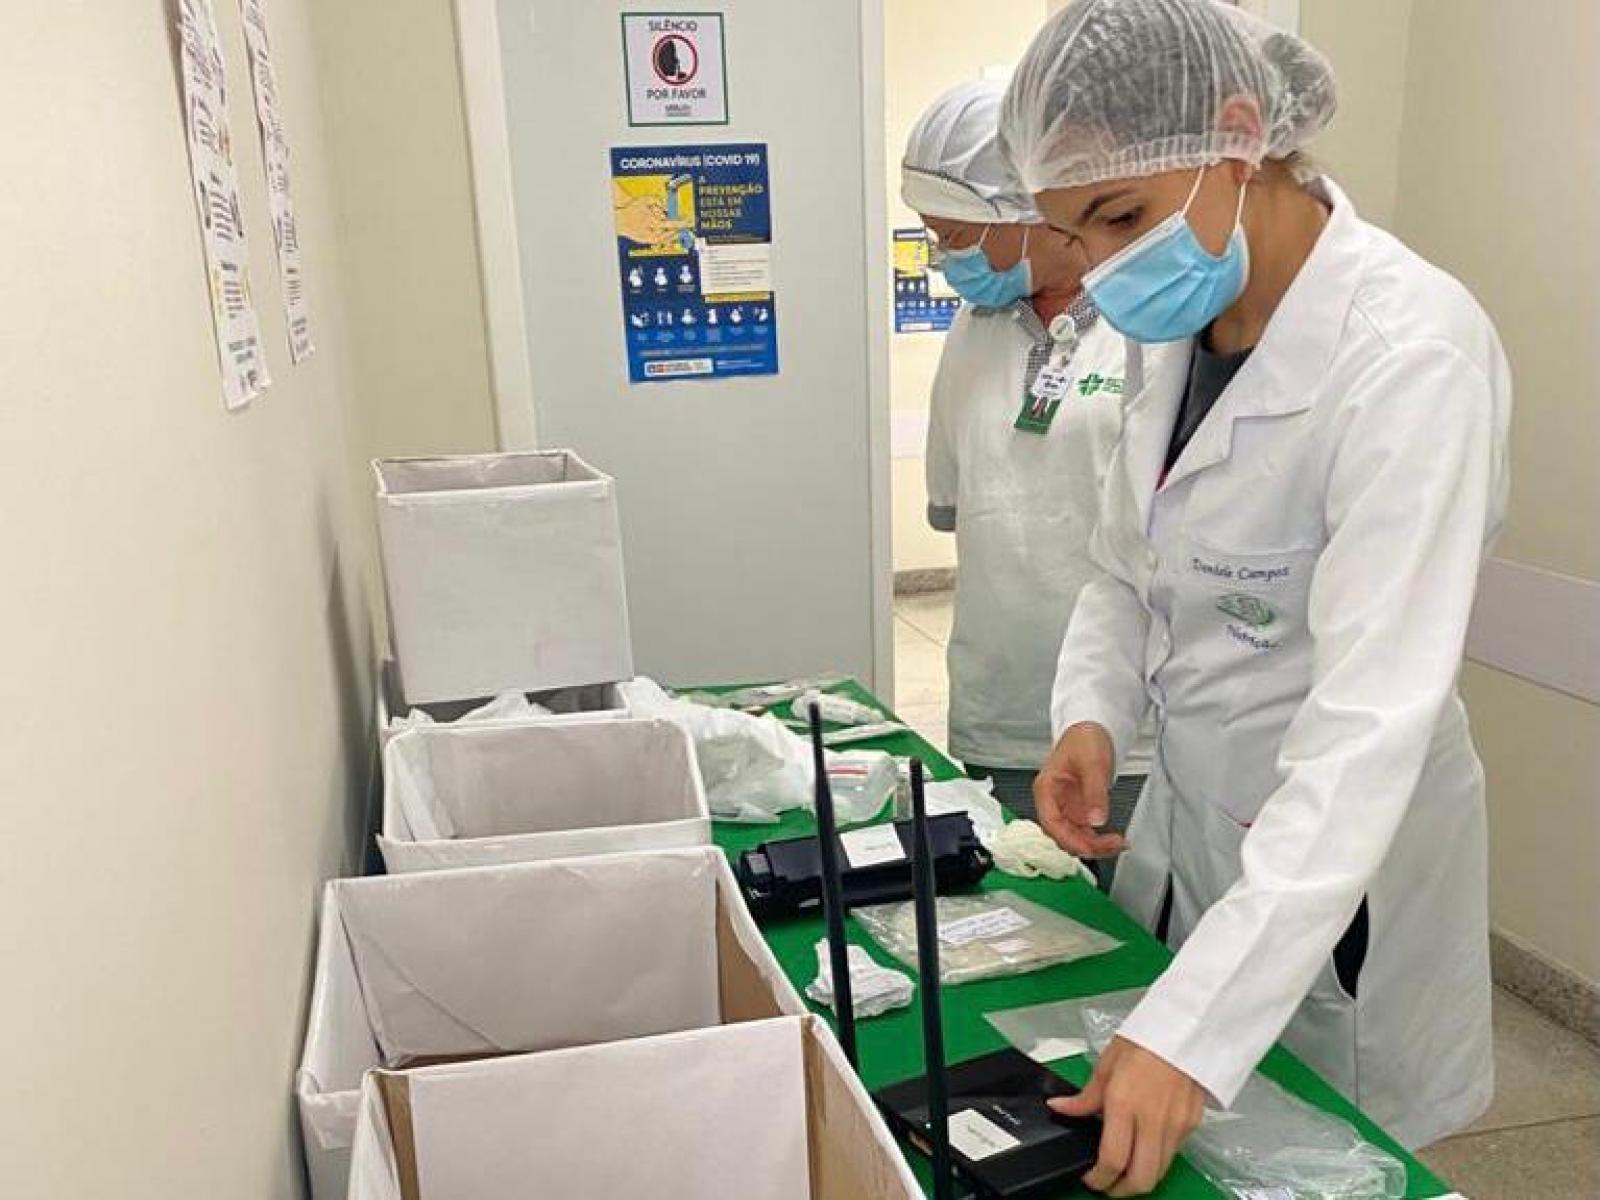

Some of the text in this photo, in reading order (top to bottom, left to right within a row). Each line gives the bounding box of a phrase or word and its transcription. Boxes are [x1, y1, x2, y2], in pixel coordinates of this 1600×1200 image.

[649, 19, 697, 31] SILÊNCIO
[647, 88, 706, 100] POR FAVOR
[620, 155, 701, 169] CORONAVÍRUS
[699, 183, 764, 196] PREVENÇÃO
[727, 196, 742, 205] EM
[701, 208, 742, 218] NOSSAS
[701, 219, 733, 230] MÃOS
